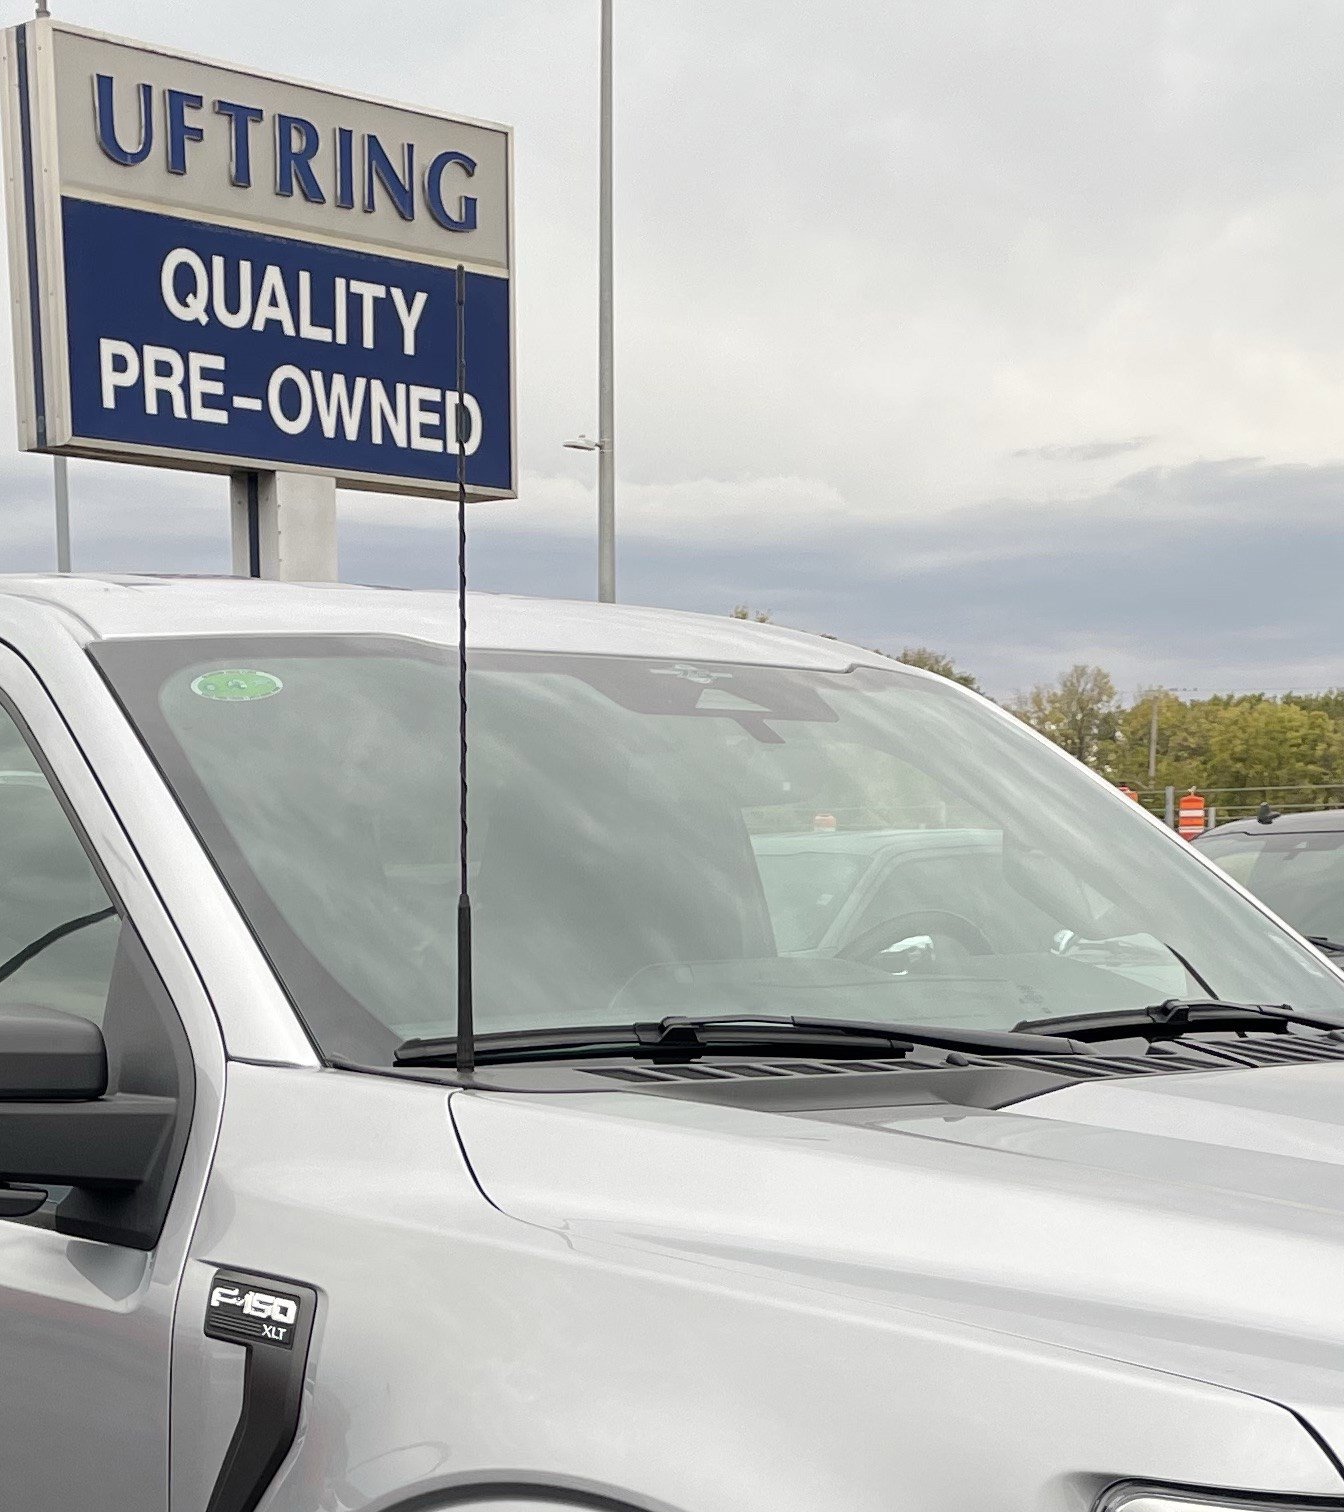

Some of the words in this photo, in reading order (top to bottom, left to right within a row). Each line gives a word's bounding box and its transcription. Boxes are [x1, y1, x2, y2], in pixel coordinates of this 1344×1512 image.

[91, 73, 479, 234] UFTRING
[160, 247, 429, 356] QUALITY
[99, 337, 484, 457] PRE-OWNED
[210, 1286, 298, 1325] F-150
[261, 1323, 288, 1341] XLT
